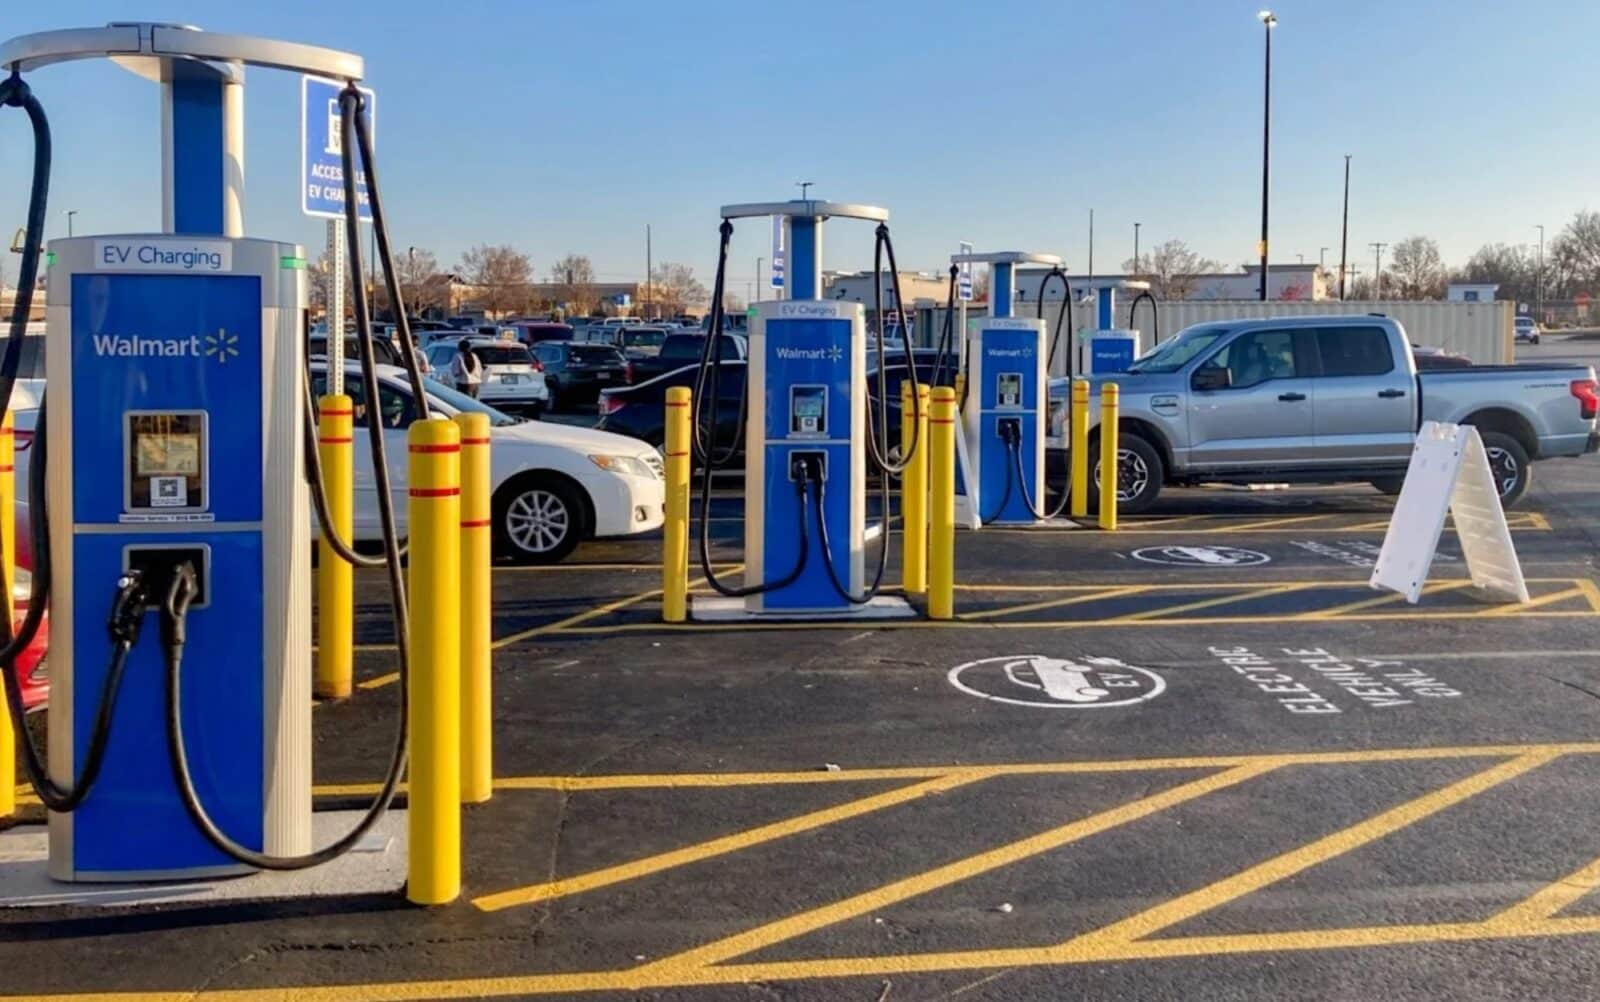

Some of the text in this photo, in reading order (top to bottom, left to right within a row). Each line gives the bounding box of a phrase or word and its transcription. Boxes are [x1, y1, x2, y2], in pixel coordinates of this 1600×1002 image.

[312, 164, 366, 184] ACCESLE
[309, 185, 369, 205] EV CHANG
[103, 246, 222, 269] EV Charging
[782, 304, 796, 314] EV
[93, 335, 200, 357] Walmart
[776, 346, 826, 360] Walmart
[1207, 646, 1343, 714] ELECTRIC
[1281, 647, 1415, 708] VEHICLE
[1356, 658, 1463, 698] ONLY
